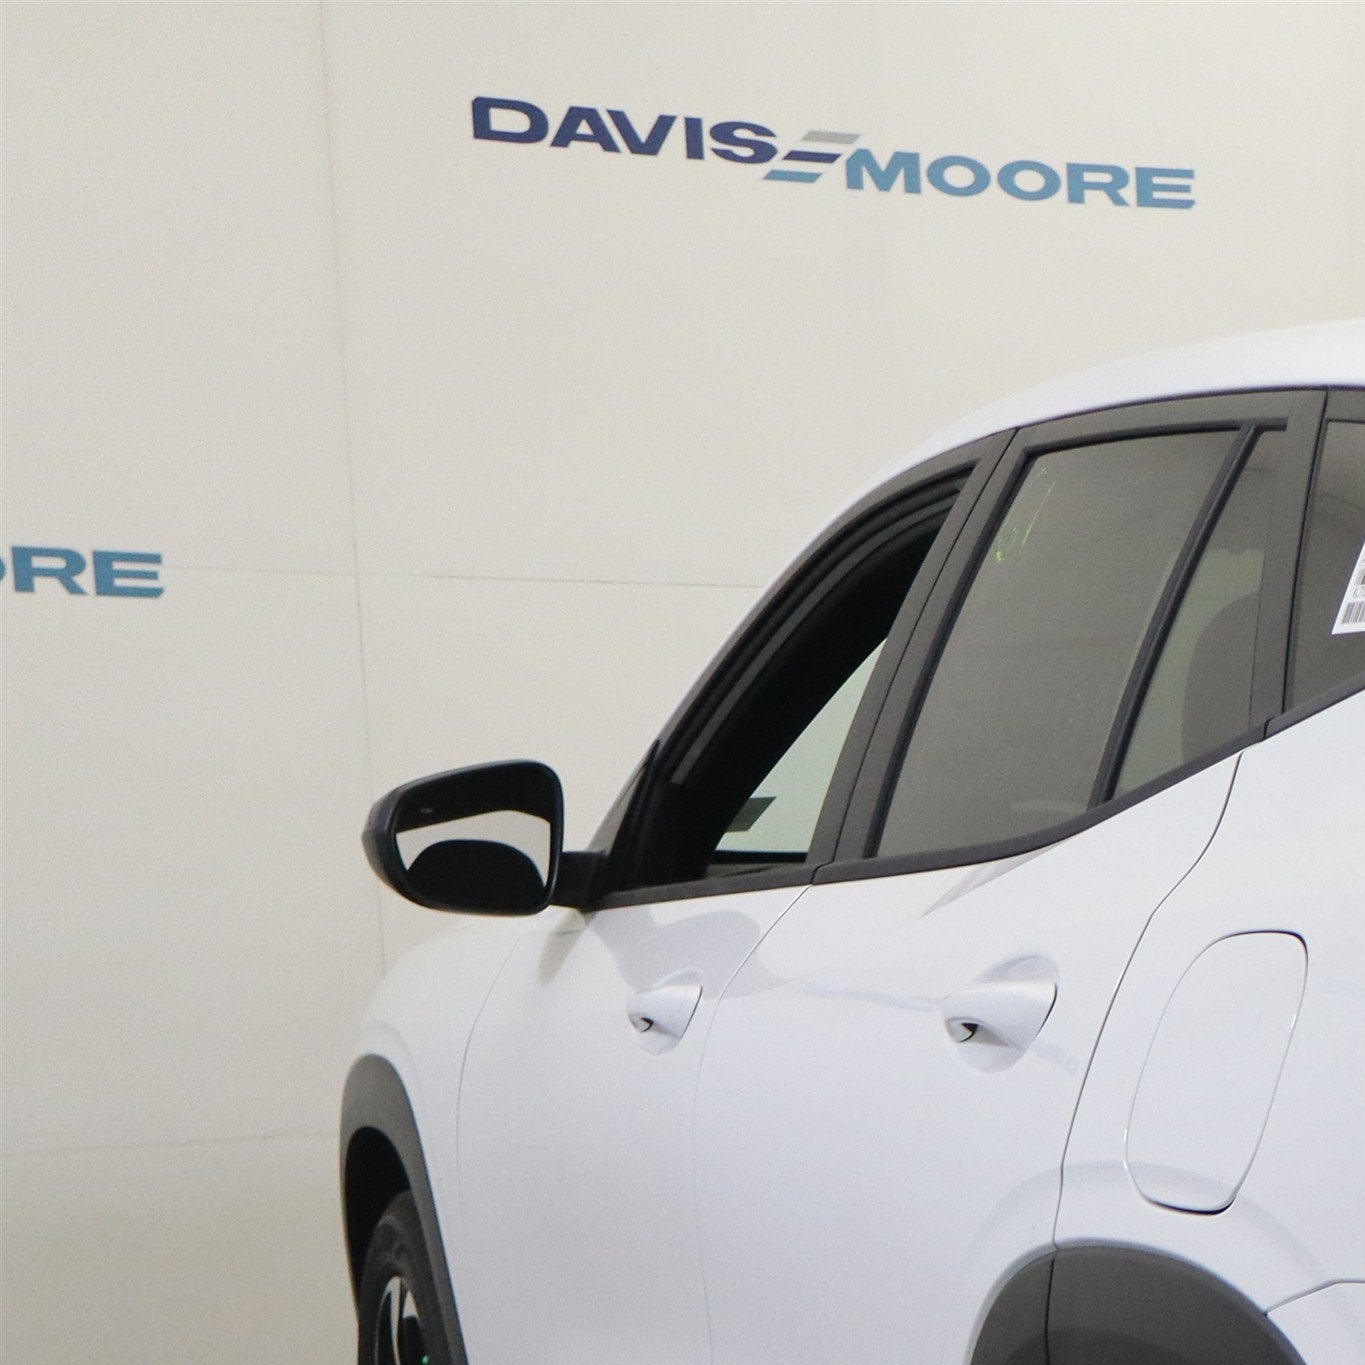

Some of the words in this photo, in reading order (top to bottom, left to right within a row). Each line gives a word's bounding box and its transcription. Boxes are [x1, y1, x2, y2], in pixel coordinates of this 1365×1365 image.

[470, 95, 779, 165] DAVIS
[844, 147, 1197, 210] MOORE
[0, 545, 165, 598] RE
